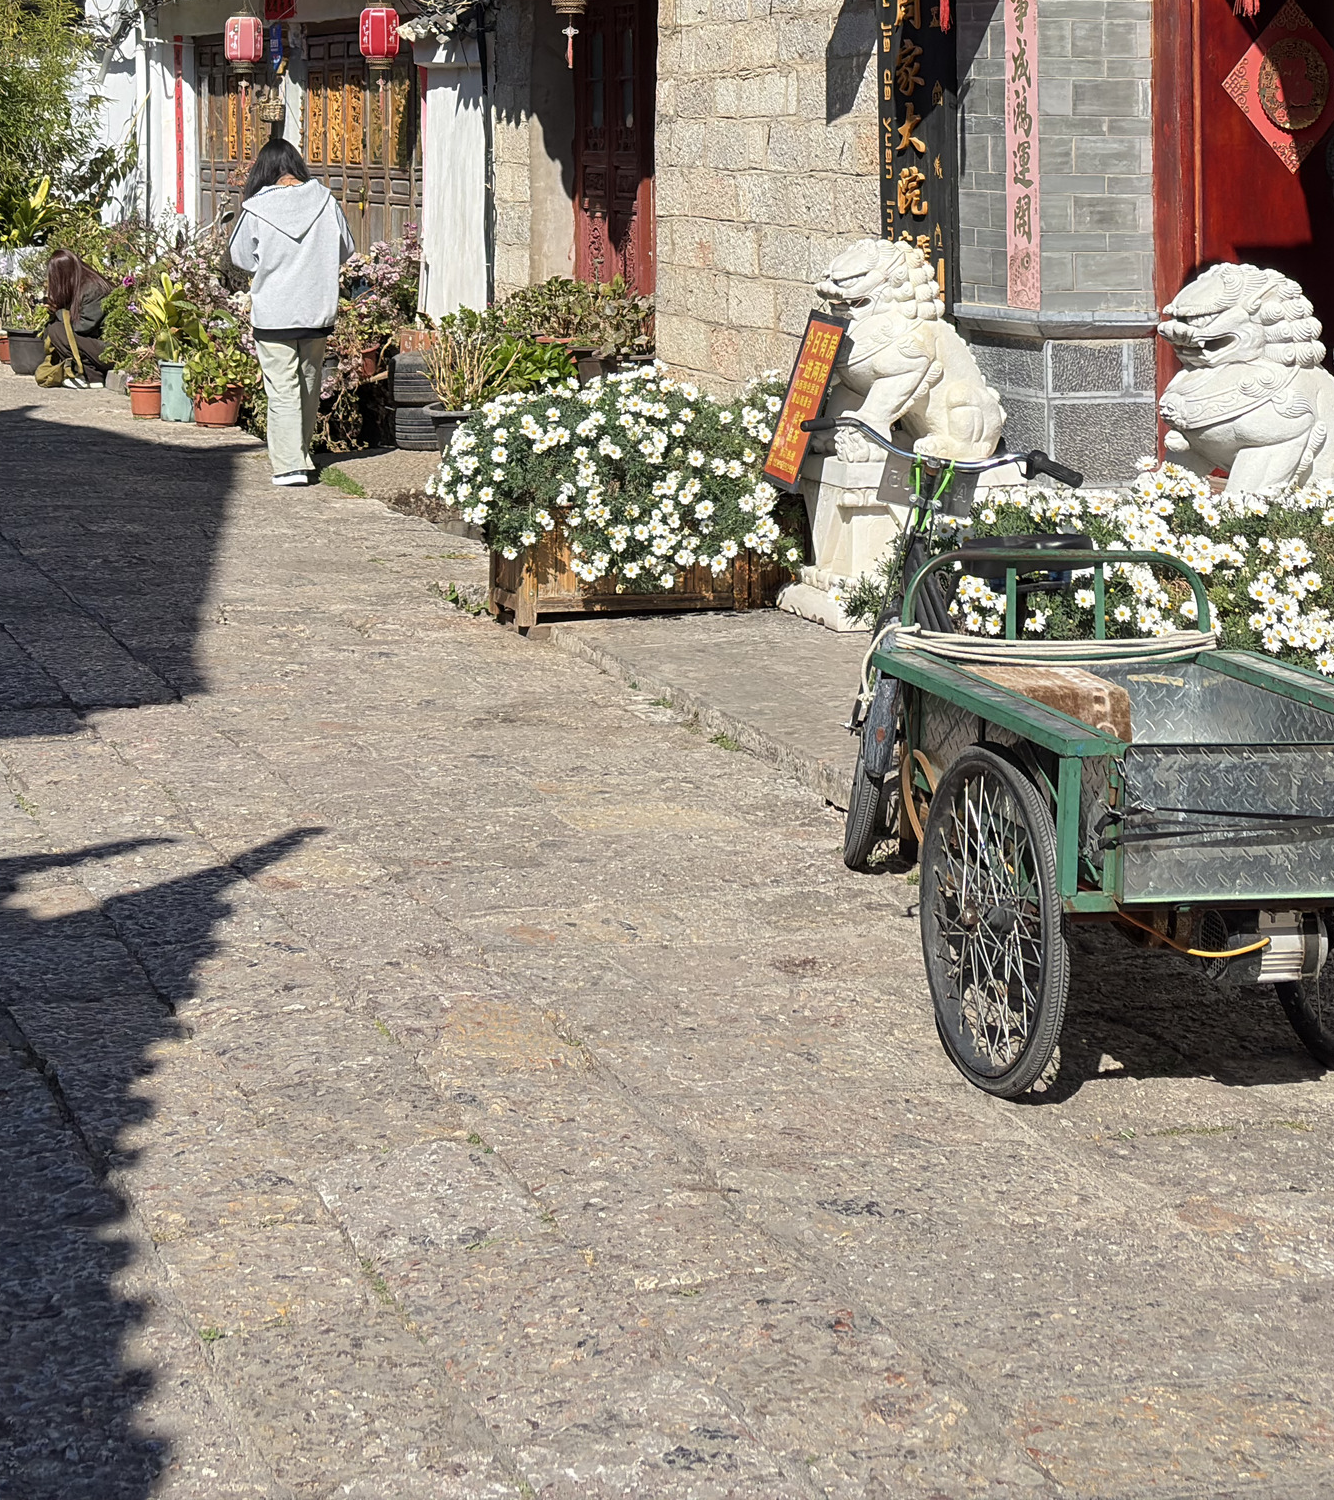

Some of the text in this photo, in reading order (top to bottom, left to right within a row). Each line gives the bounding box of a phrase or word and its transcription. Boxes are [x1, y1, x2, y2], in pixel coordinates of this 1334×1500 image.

[883, 68, 893, 101] da
[882, 117, 893, 179] yuan
[805, 327, 839, 360] 今日有房
